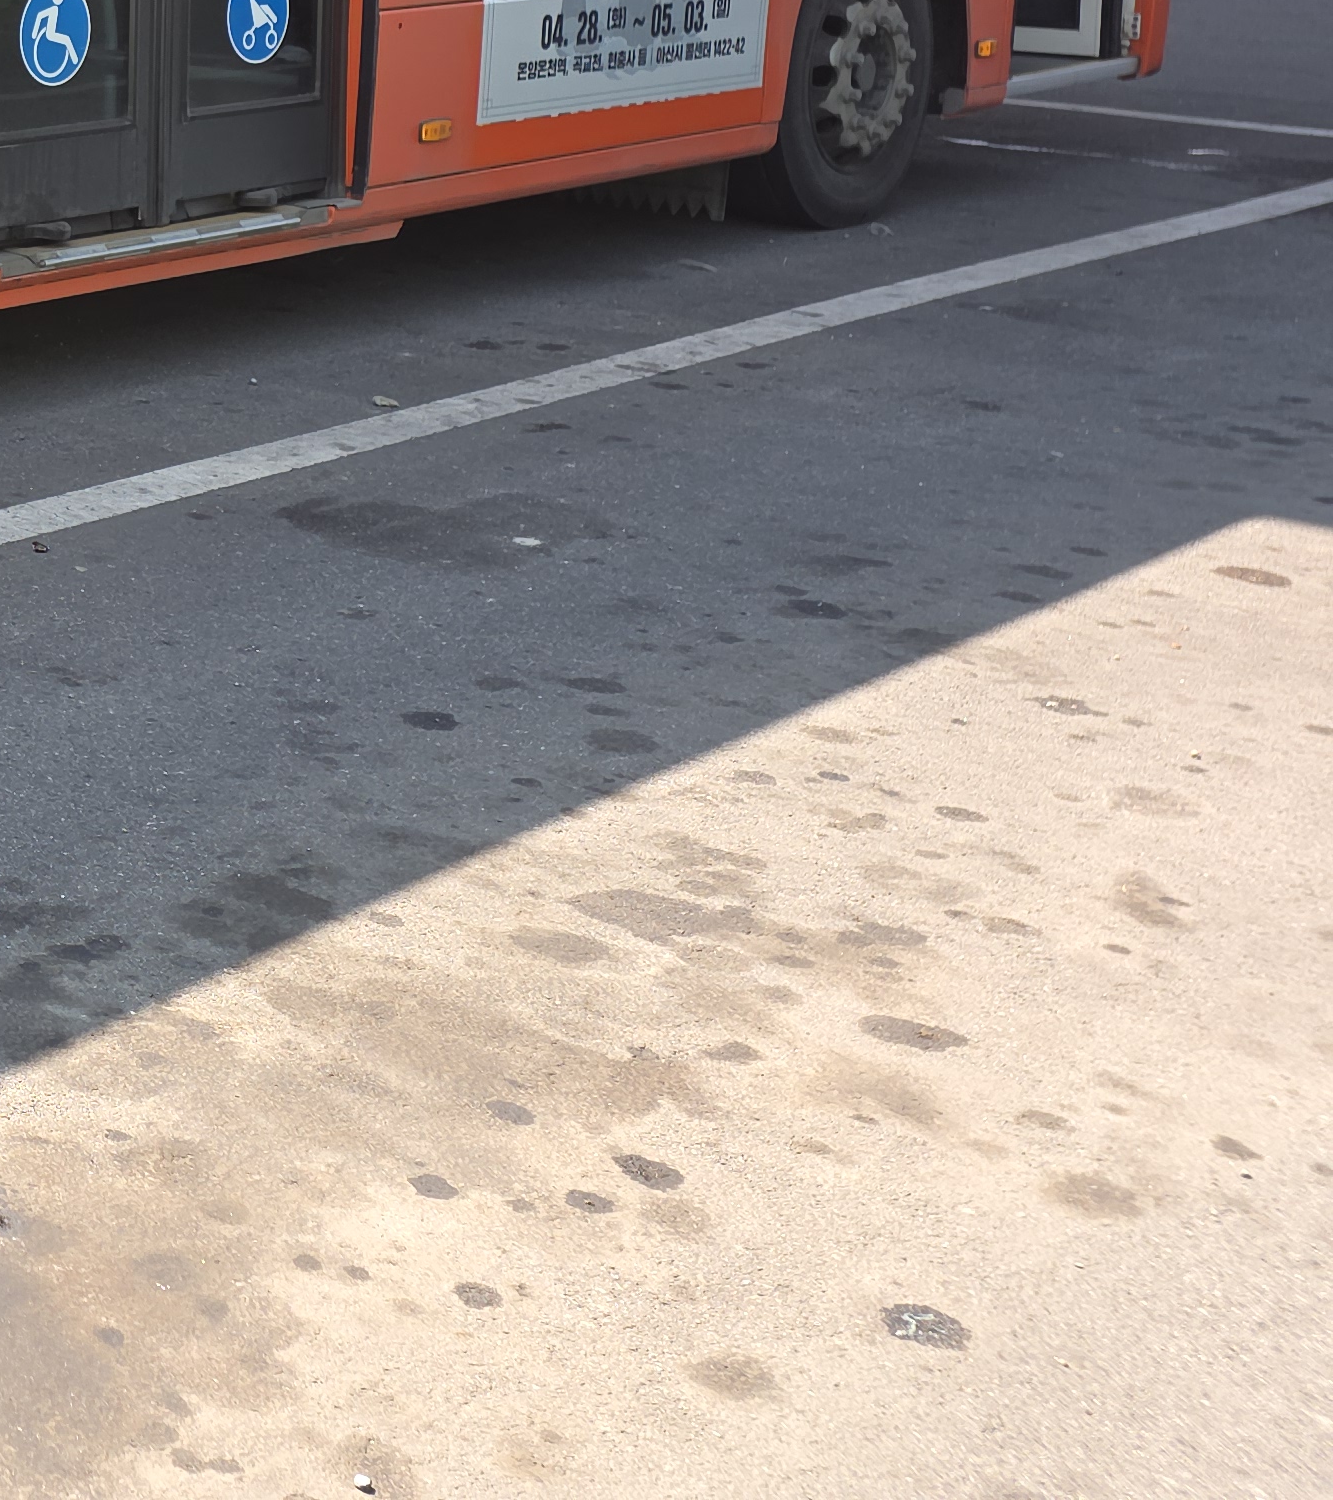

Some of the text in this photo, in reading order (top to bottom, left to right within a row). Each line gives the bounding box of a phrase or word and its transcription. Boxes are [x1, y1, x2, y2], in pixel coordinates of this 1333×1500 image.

[541, 14, 568, 50] 04.
[576, 10, 602, 45] 28.
[651, 3, 675, 37] 05.
[684, 0, 708, 34] 03.
[714, 36, 745, 57] 1422-42
